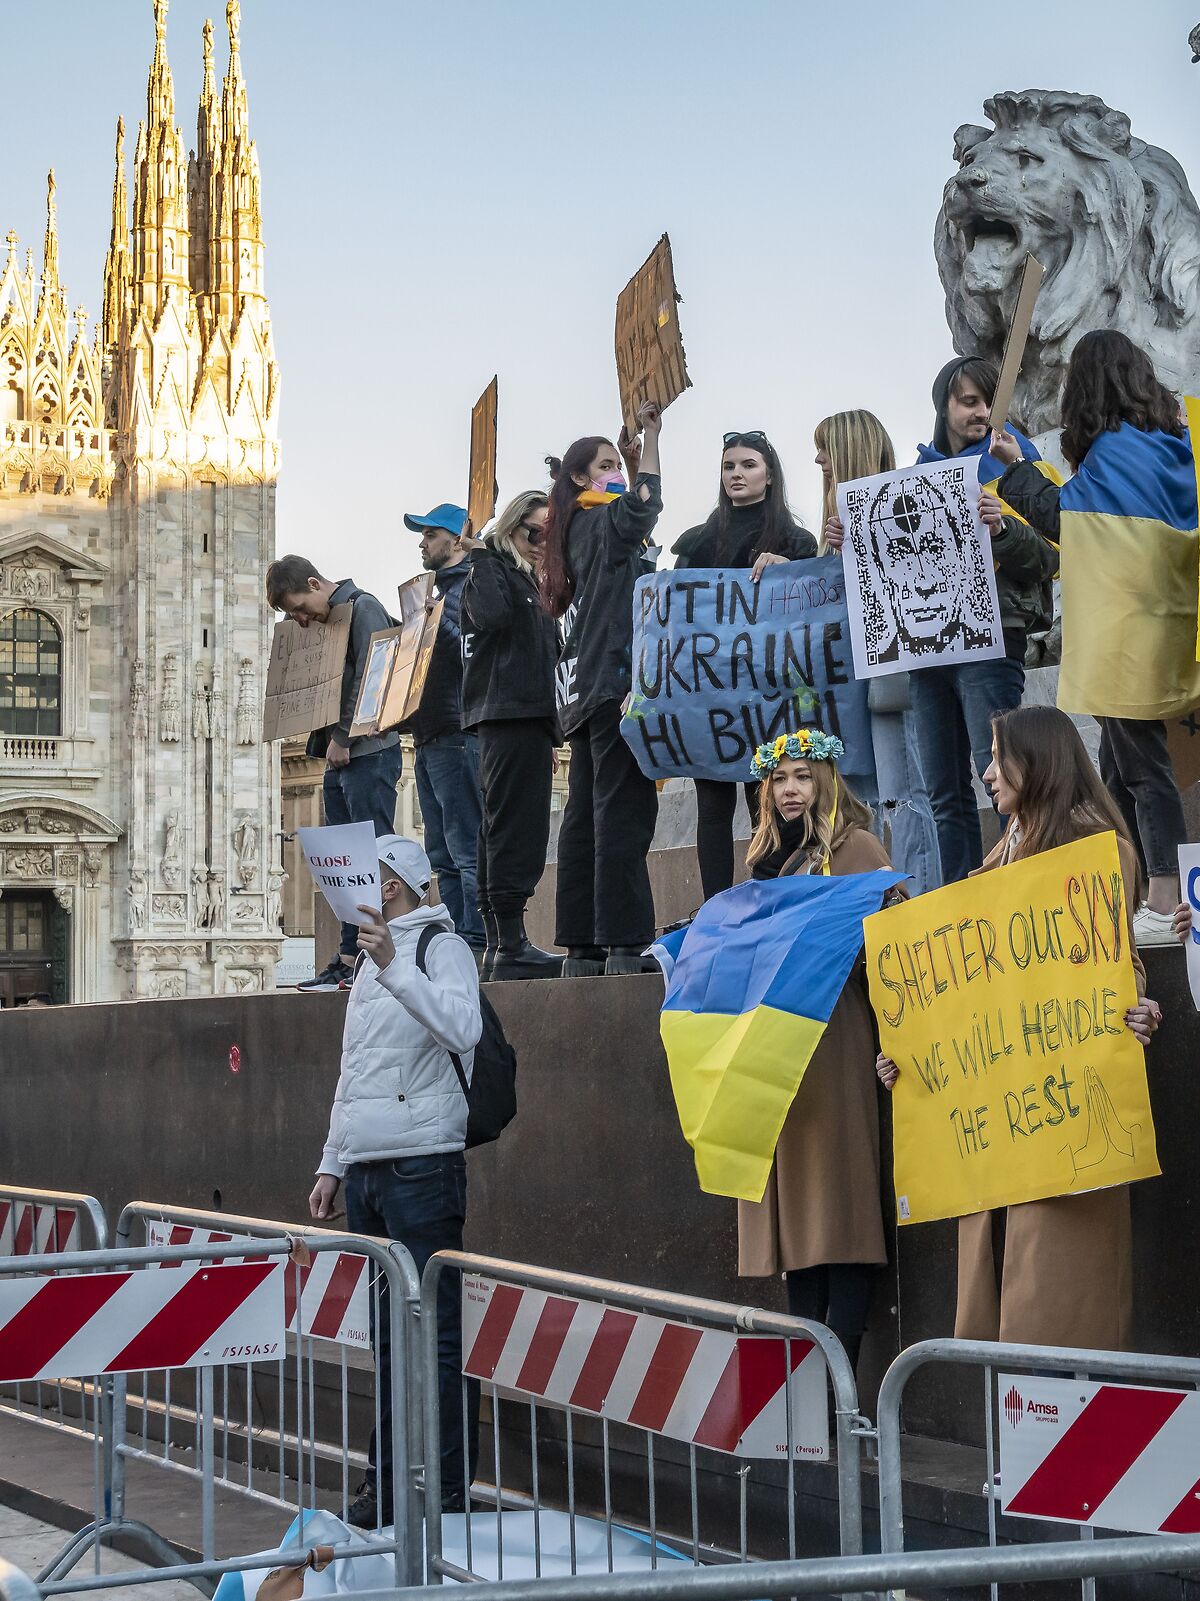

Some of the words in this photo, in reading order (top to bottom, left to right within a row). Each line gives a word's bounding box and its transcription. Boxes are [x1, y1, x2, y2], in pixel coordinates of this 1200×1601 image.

[769, 577, 827, 615] HANDS
[640, 622, 848, 699] UKRAINE
[310, 855, 351, 867] CLOSE
[320, 874, 345, 887] THE
[347, 872, 376, 887] SKY
[878, 917, 1005, 1028] SHELTER
[1065, 870, 1124, 967] SKY
[911, 1041, 950, 1094] WE
[1020, 987, 1125, 1056] HENDLE
[950, 1104, 989, 1159] THE
[1027, 1400, 1058, 1415] Amsa
[796, 1446, 824, 1454] (Perugia)
